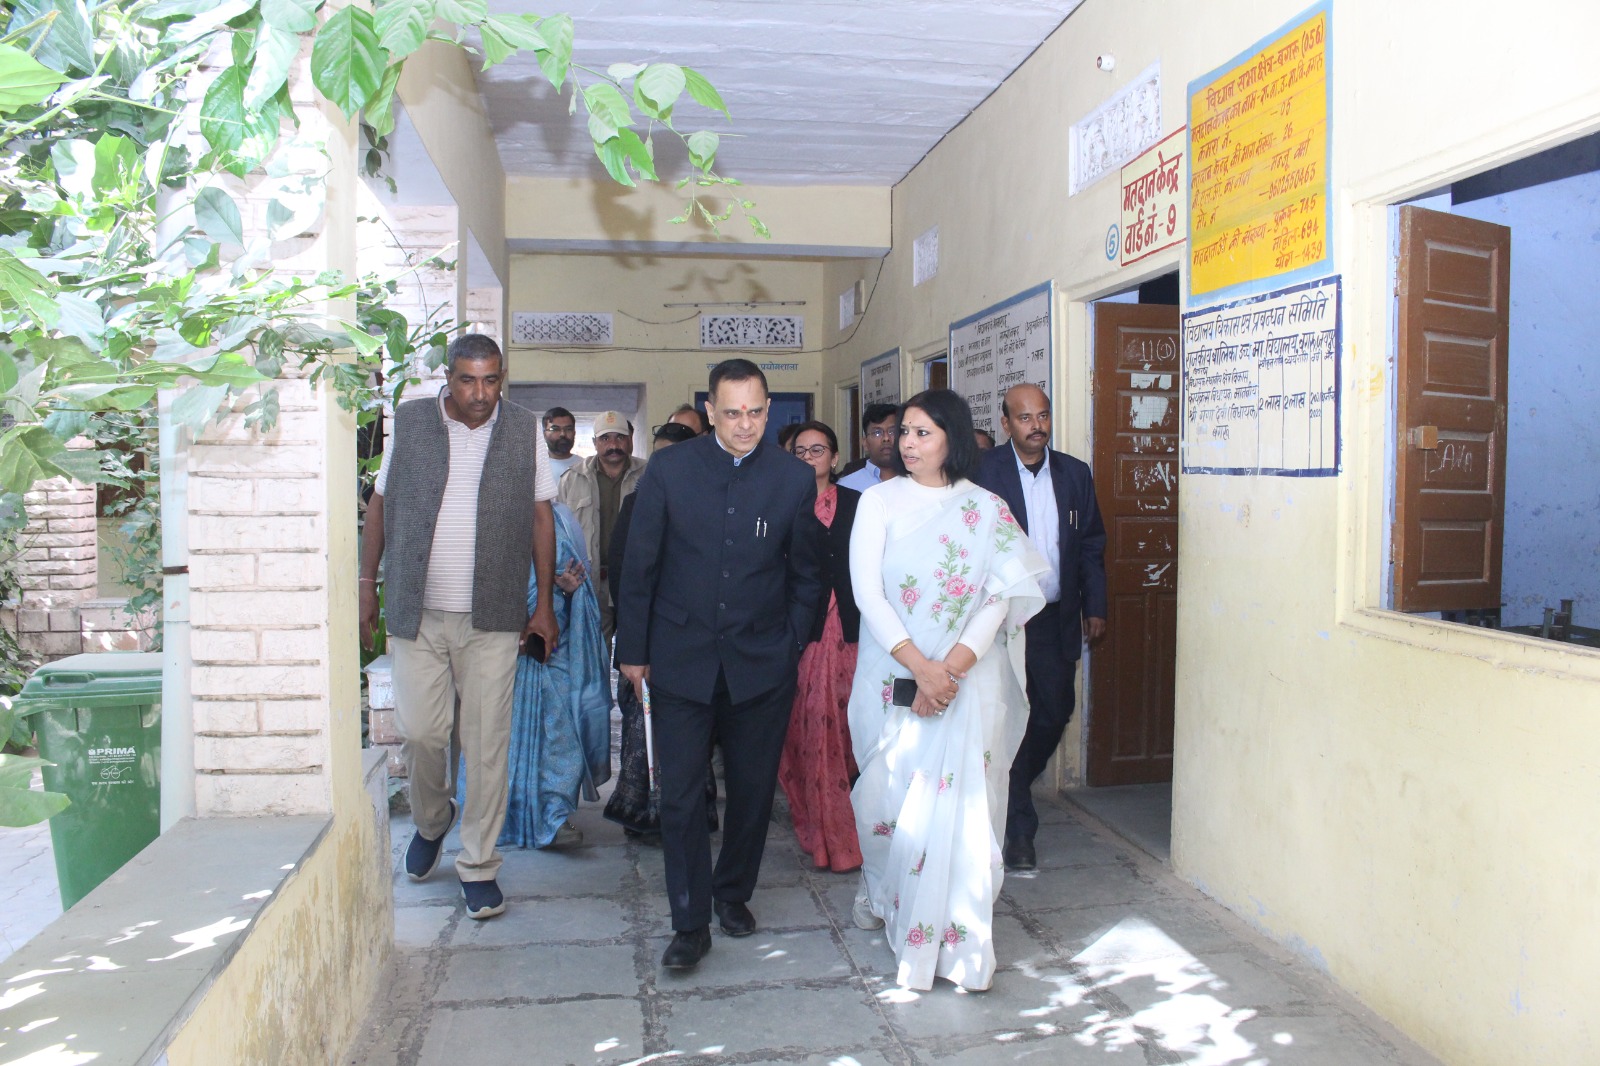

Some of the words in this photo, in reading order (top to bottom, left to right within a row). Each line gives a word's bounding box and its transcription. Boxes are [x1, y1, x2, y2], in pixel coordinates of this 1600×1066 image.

[1123, 168, 1158, 212] मतदान
[1156, 150, 1183, 195] केन्द्र
[1124, 207, 1145, 256] वार्ड
[1166, 203, 1177, 237] 9
[1229, 227, 1242, 251] की
[1300, 193, 1318, 214] 745
[1215, 314, 1242, 338] विकास
[1252, 305, 1287, 335] प्रबन्धन
[1186, 344, 1213, 369] राजकीय
[1211, 340, 1239, 366] बालिका
[1264, 394, 1282, 411] लाख
[1289, 391, 1307, 409] लाख
[96, 746, 135, 755] PRIMA
